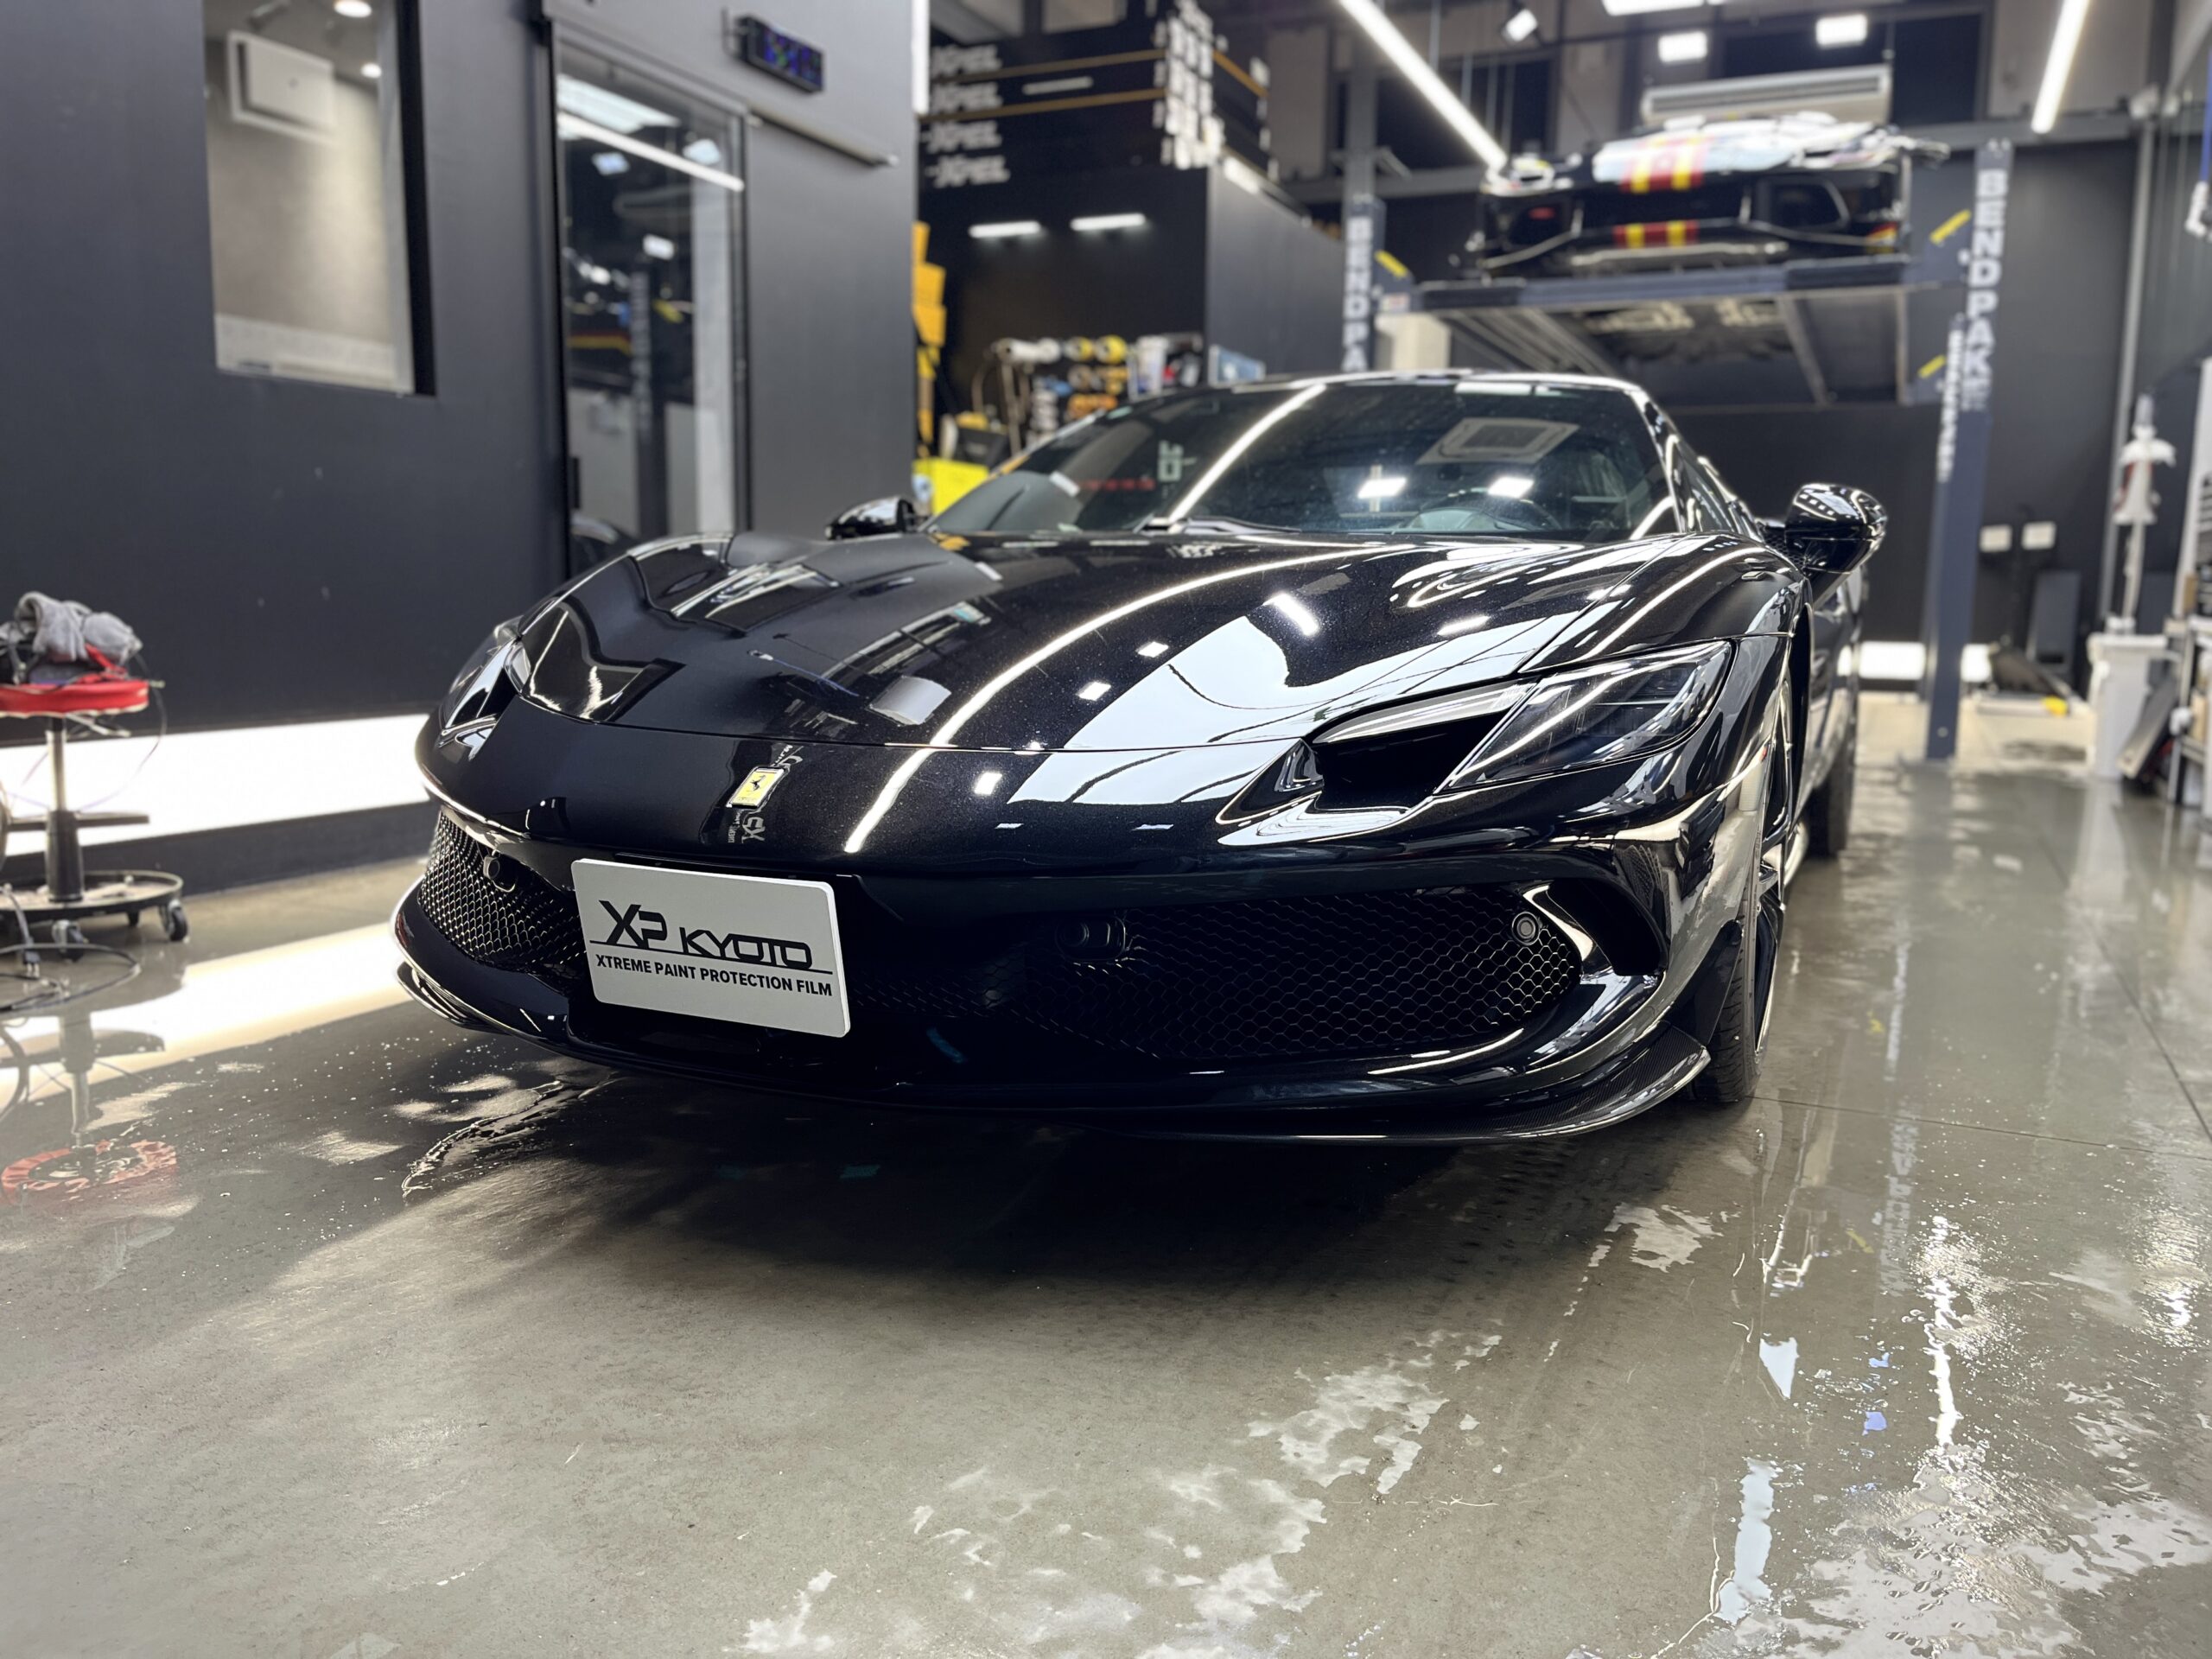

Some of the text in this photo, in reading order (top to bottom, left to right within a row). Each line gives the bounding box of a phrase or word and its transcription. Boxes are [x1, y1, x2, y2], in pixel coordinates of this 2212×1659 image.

[598, 899, 813, 969] XP KYOTO
[595, 954, 833, 997] XTREME PAINT PROTECTION FILM
